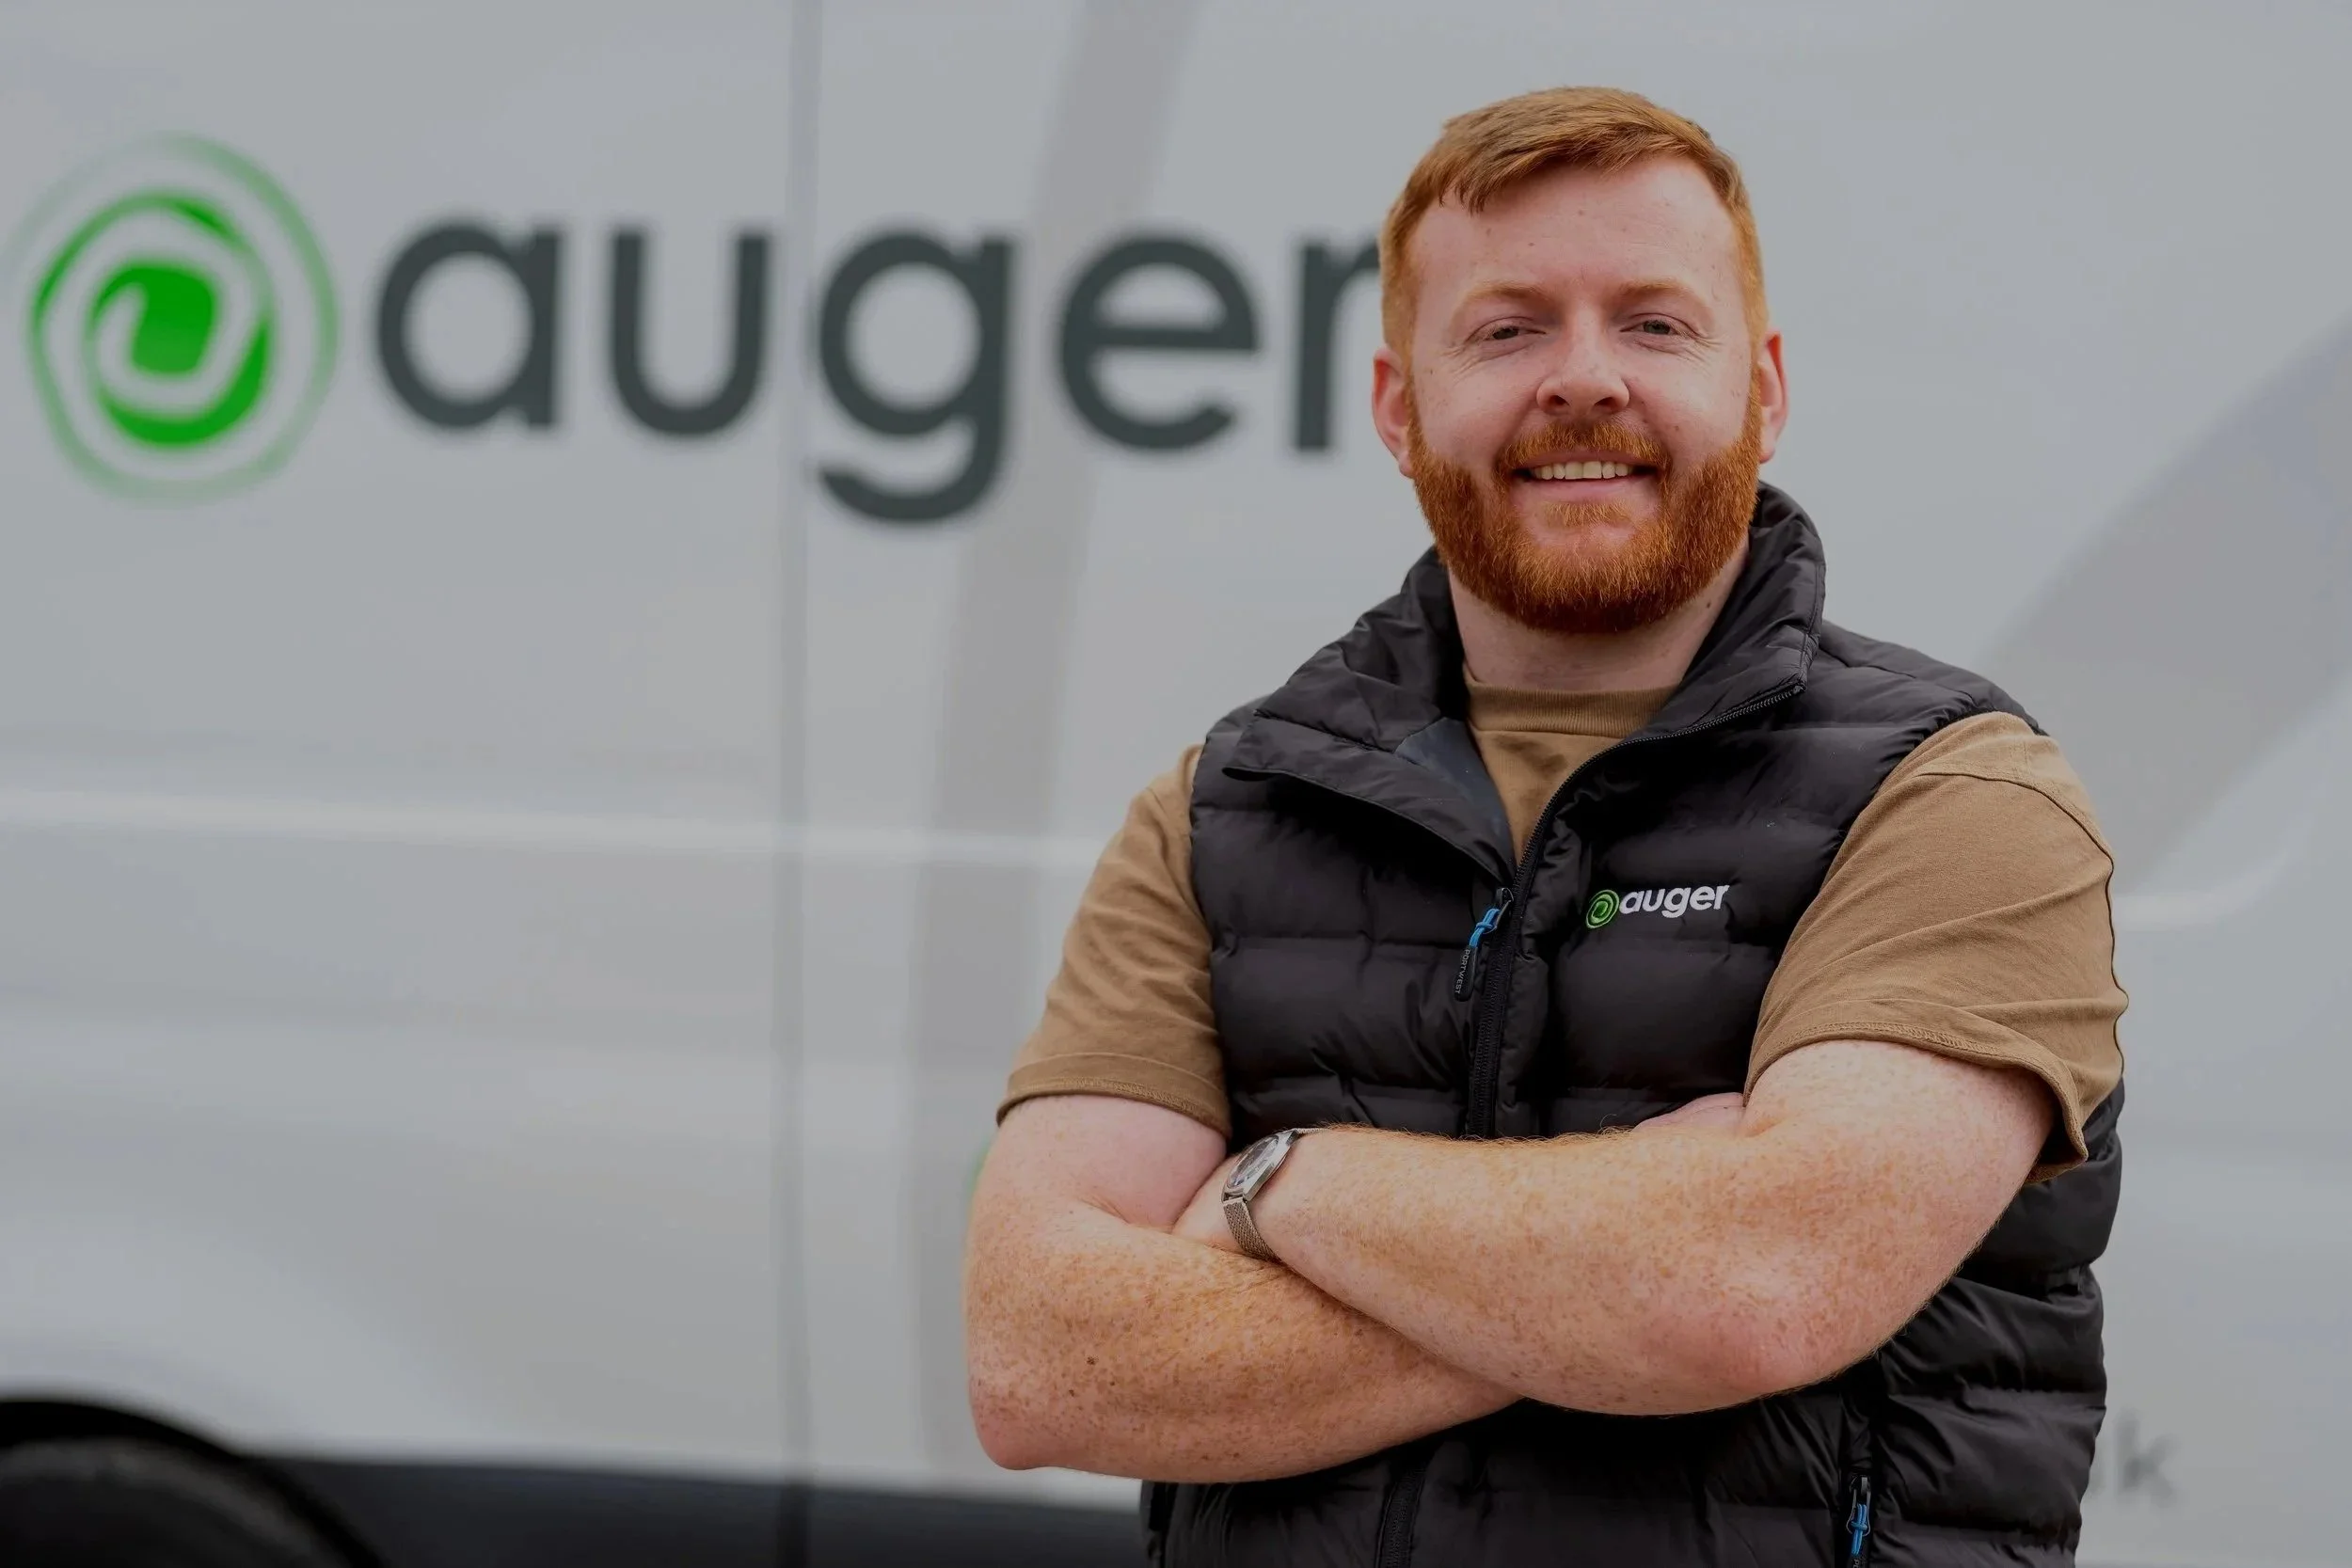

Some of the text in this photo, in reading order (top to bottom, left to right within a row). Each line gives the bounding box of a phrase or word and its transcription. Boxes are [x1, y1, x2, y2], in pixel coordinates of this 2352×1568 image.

[374, 222, 1379, 527] auger
[1618, 884, 1730, 919] auger
[1454, 949, 1470, 994] PORTWEST
